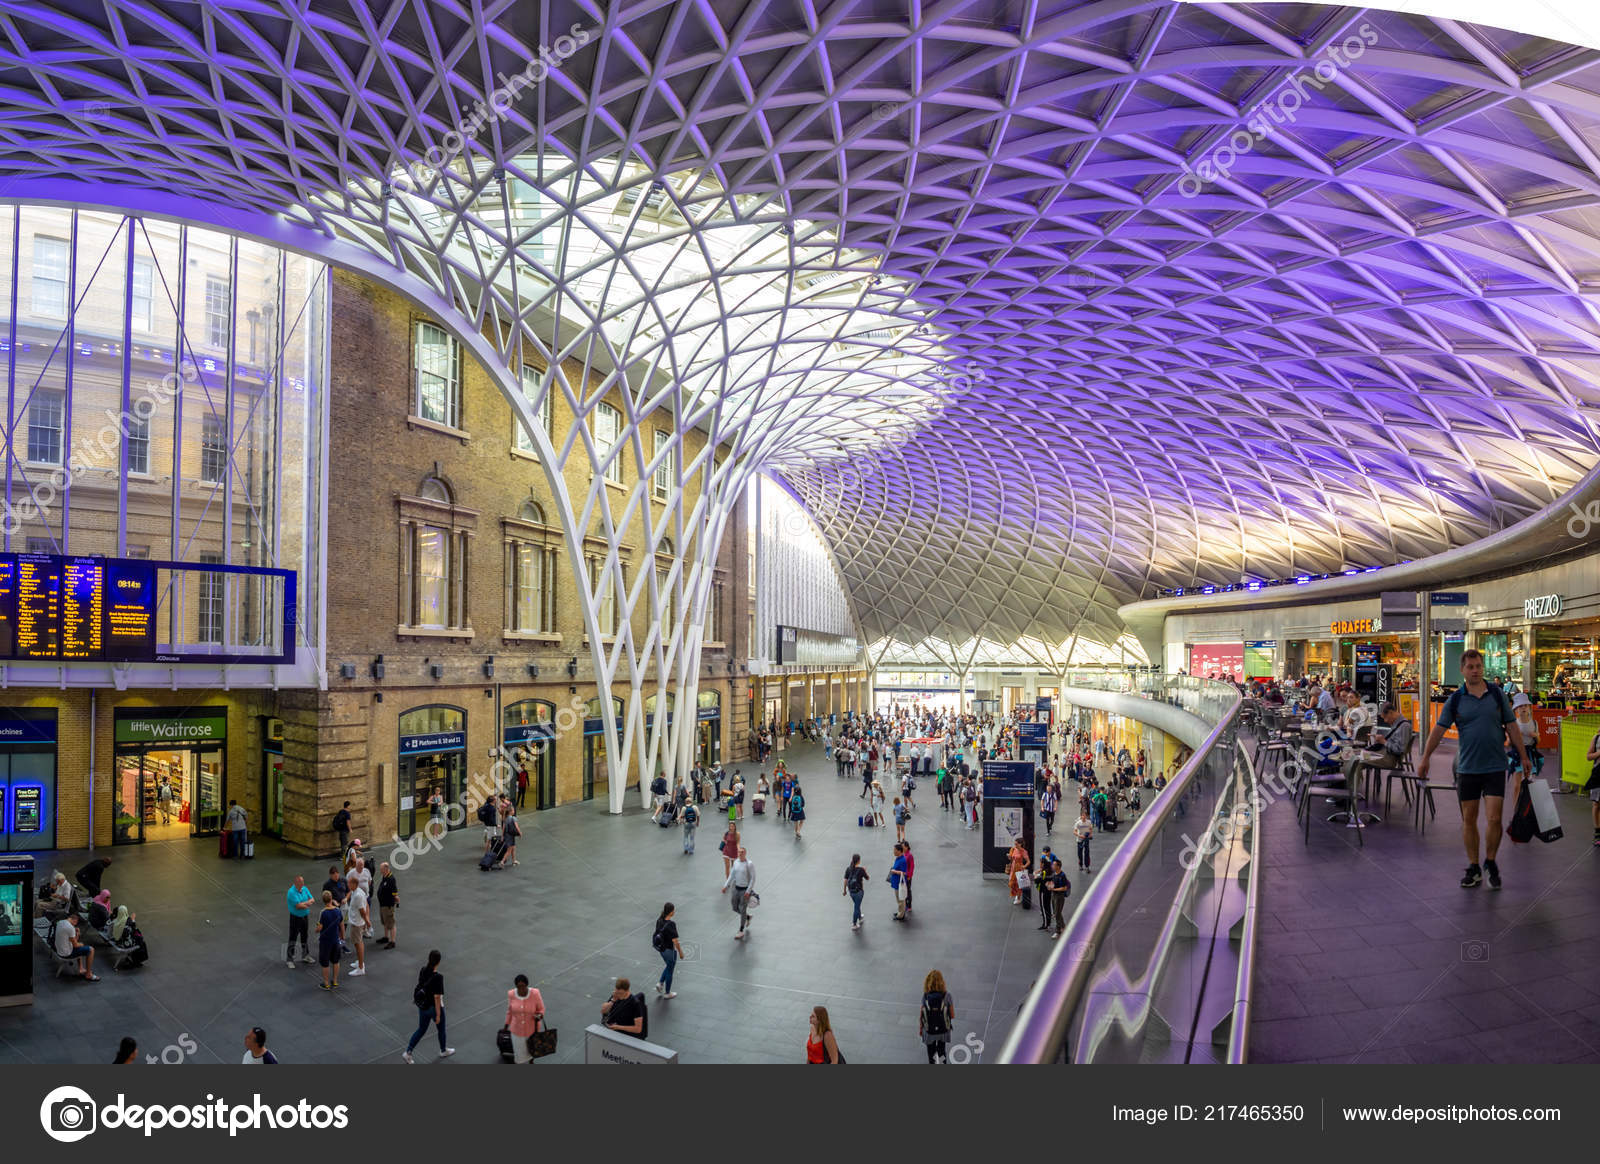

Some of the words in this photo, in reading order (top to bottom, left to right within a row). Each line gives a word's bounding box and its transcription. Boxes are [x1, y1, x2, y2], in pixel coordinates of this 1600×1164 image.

[1524, 594, 1561, 619] PREZZO
[1330, 619, 1372, 634] GIRAFFE
[130, 721, 150, 732] little
[150, 722, 212, 737] Waitrose
